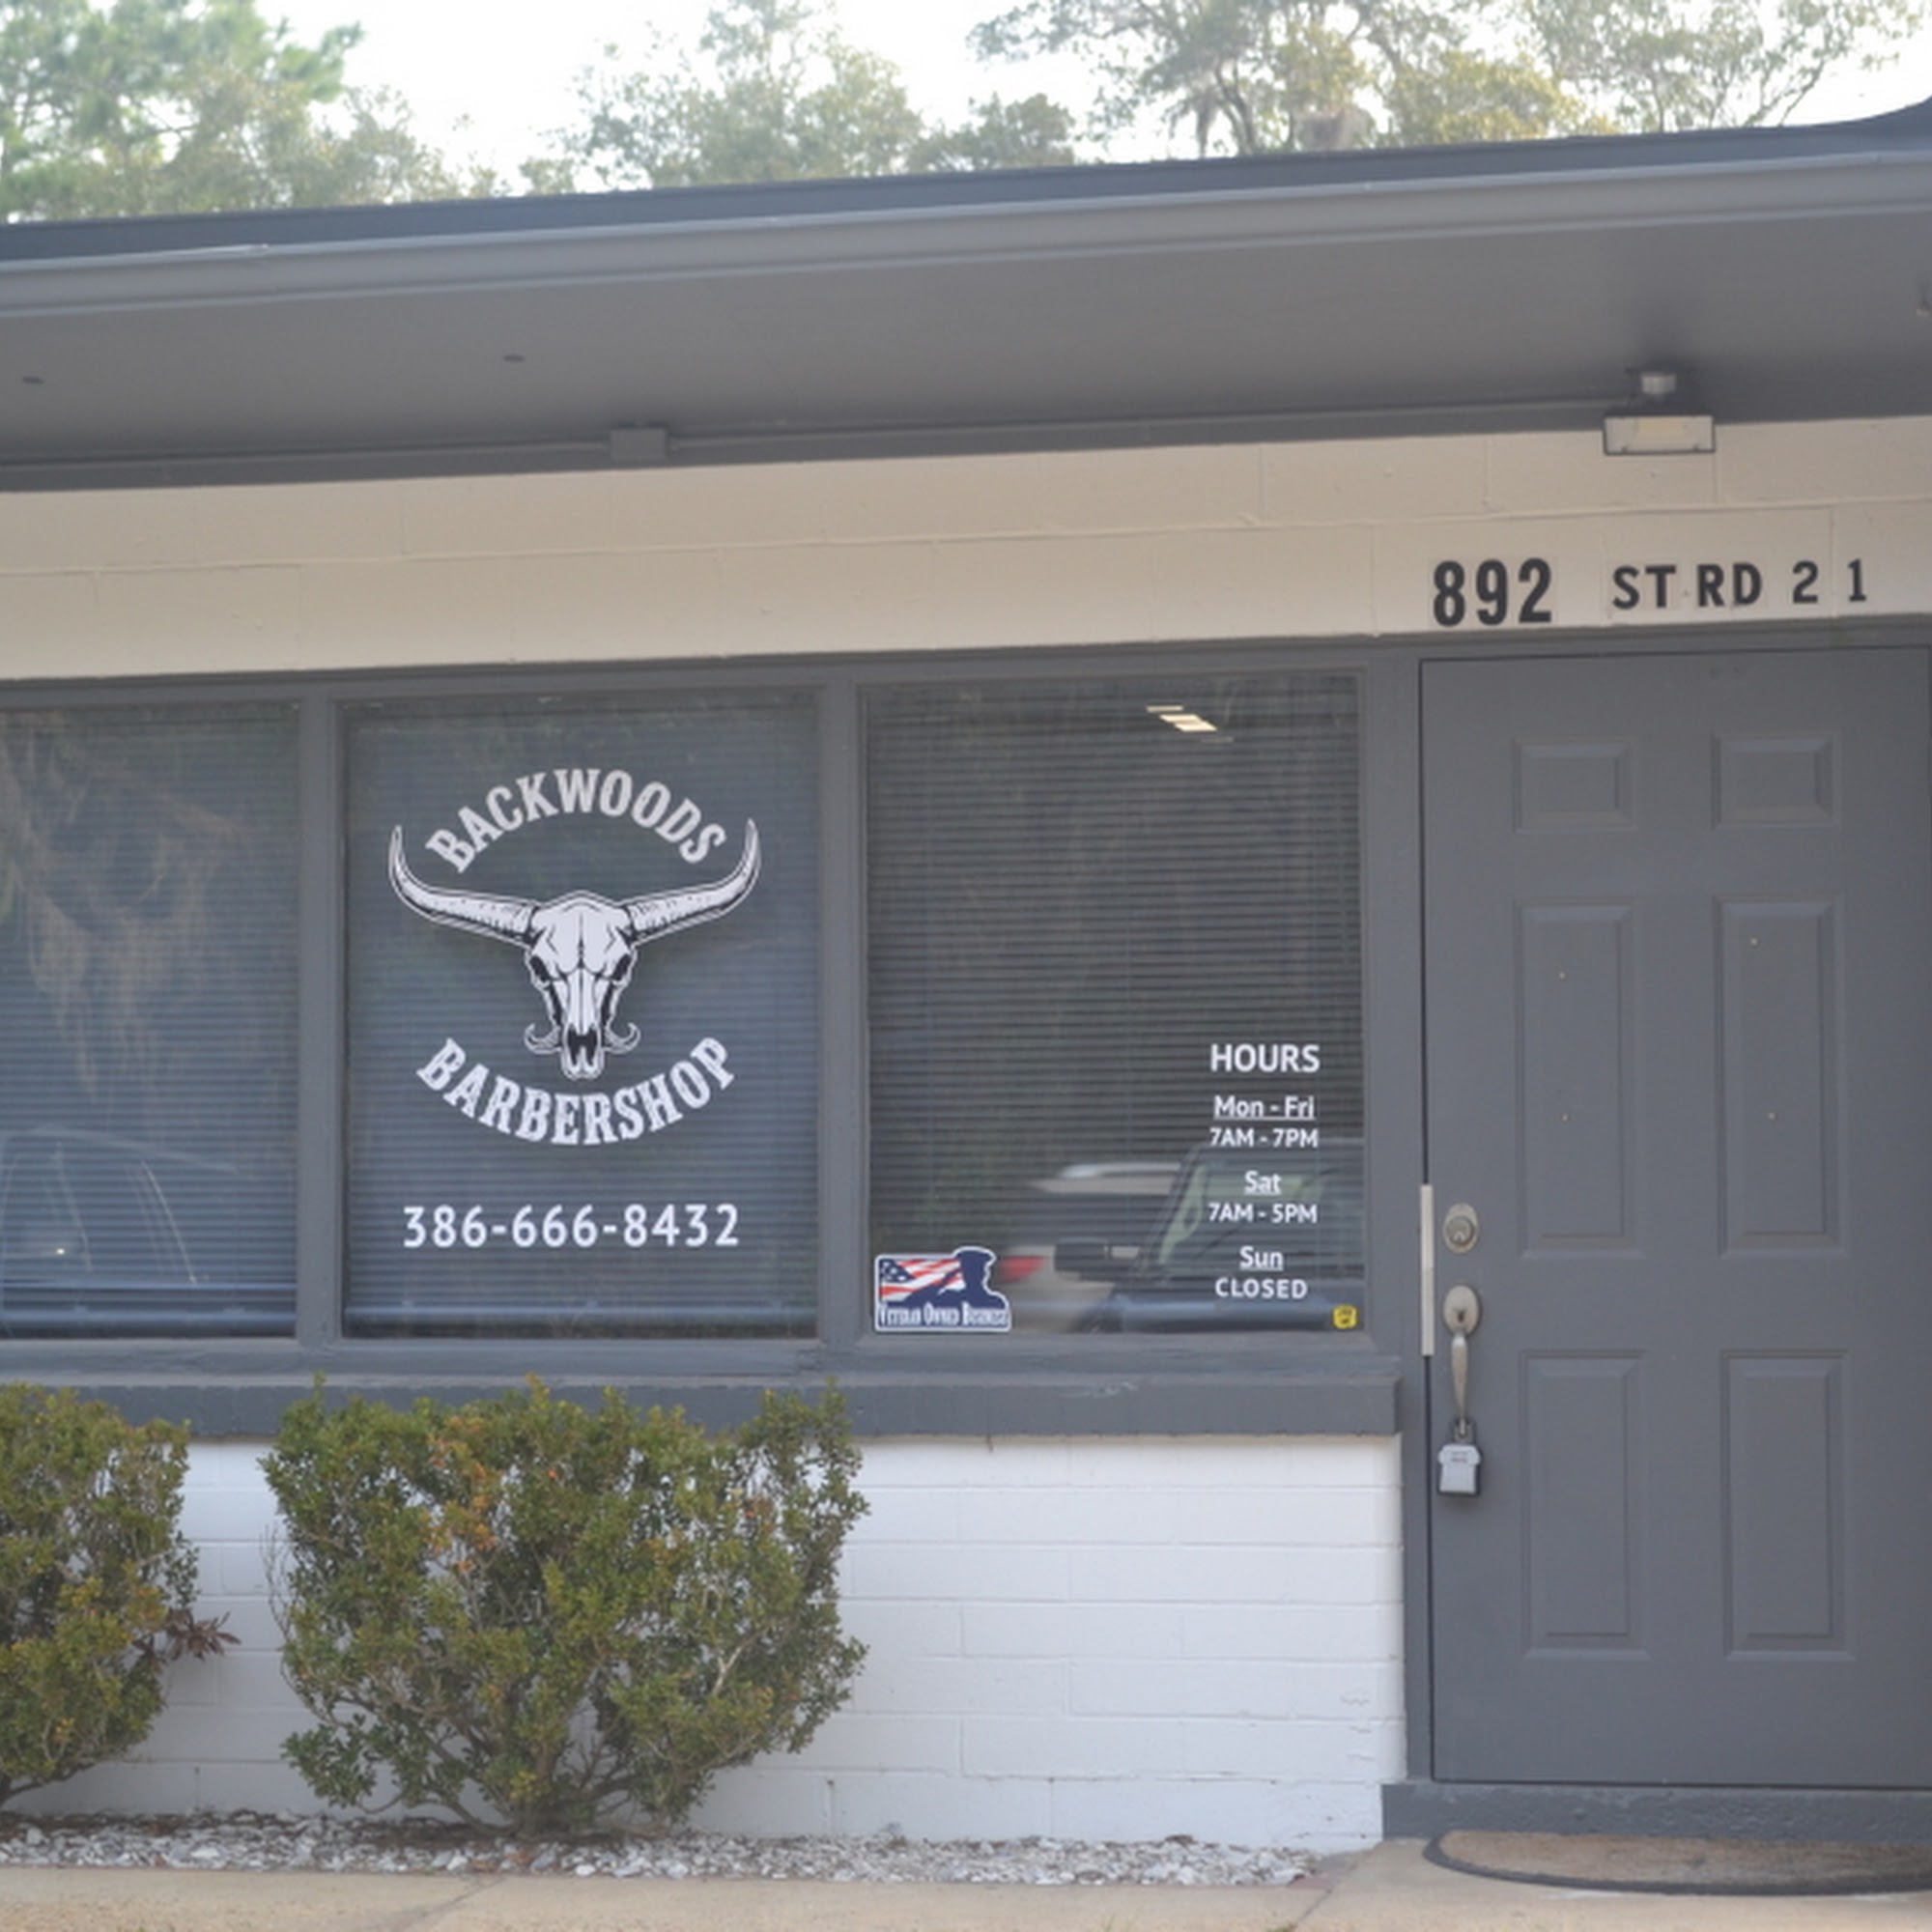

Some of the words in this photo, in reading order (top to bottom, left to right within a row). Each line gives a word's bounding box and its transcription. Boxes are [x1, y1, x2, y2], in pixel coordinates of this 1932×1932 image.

[1434, 557, 1551, 628] 892
[1612, 564, 1676, 611] ST
[1697, 561, 1762, 608] RD
[425, 769, 726, 873] BACKWOODS
[1210, 1043, 1321, 1073] HOURS
[415, 1037, 736, 1146] BARBERSHOP
[1214, 1095, 1264, 1118] Mon
[1285, 1095, 1315, 1118] Fri
[1209, 1127, 1254, 1148] 7AM
[1273, 1128, 1318, 1148] 7PM
[1244, 1170, 1282, 1195] Sat
[403, 1204, 739, 1249] 386-666-8432
[1208, 1204, 1253, 1222] 7AM
[1272, 1204, 1318, 1223] 5PM
[1239, 1246, 1284, 1270] Sun
[1215, 1278, 1308, 1299] CLOSED
